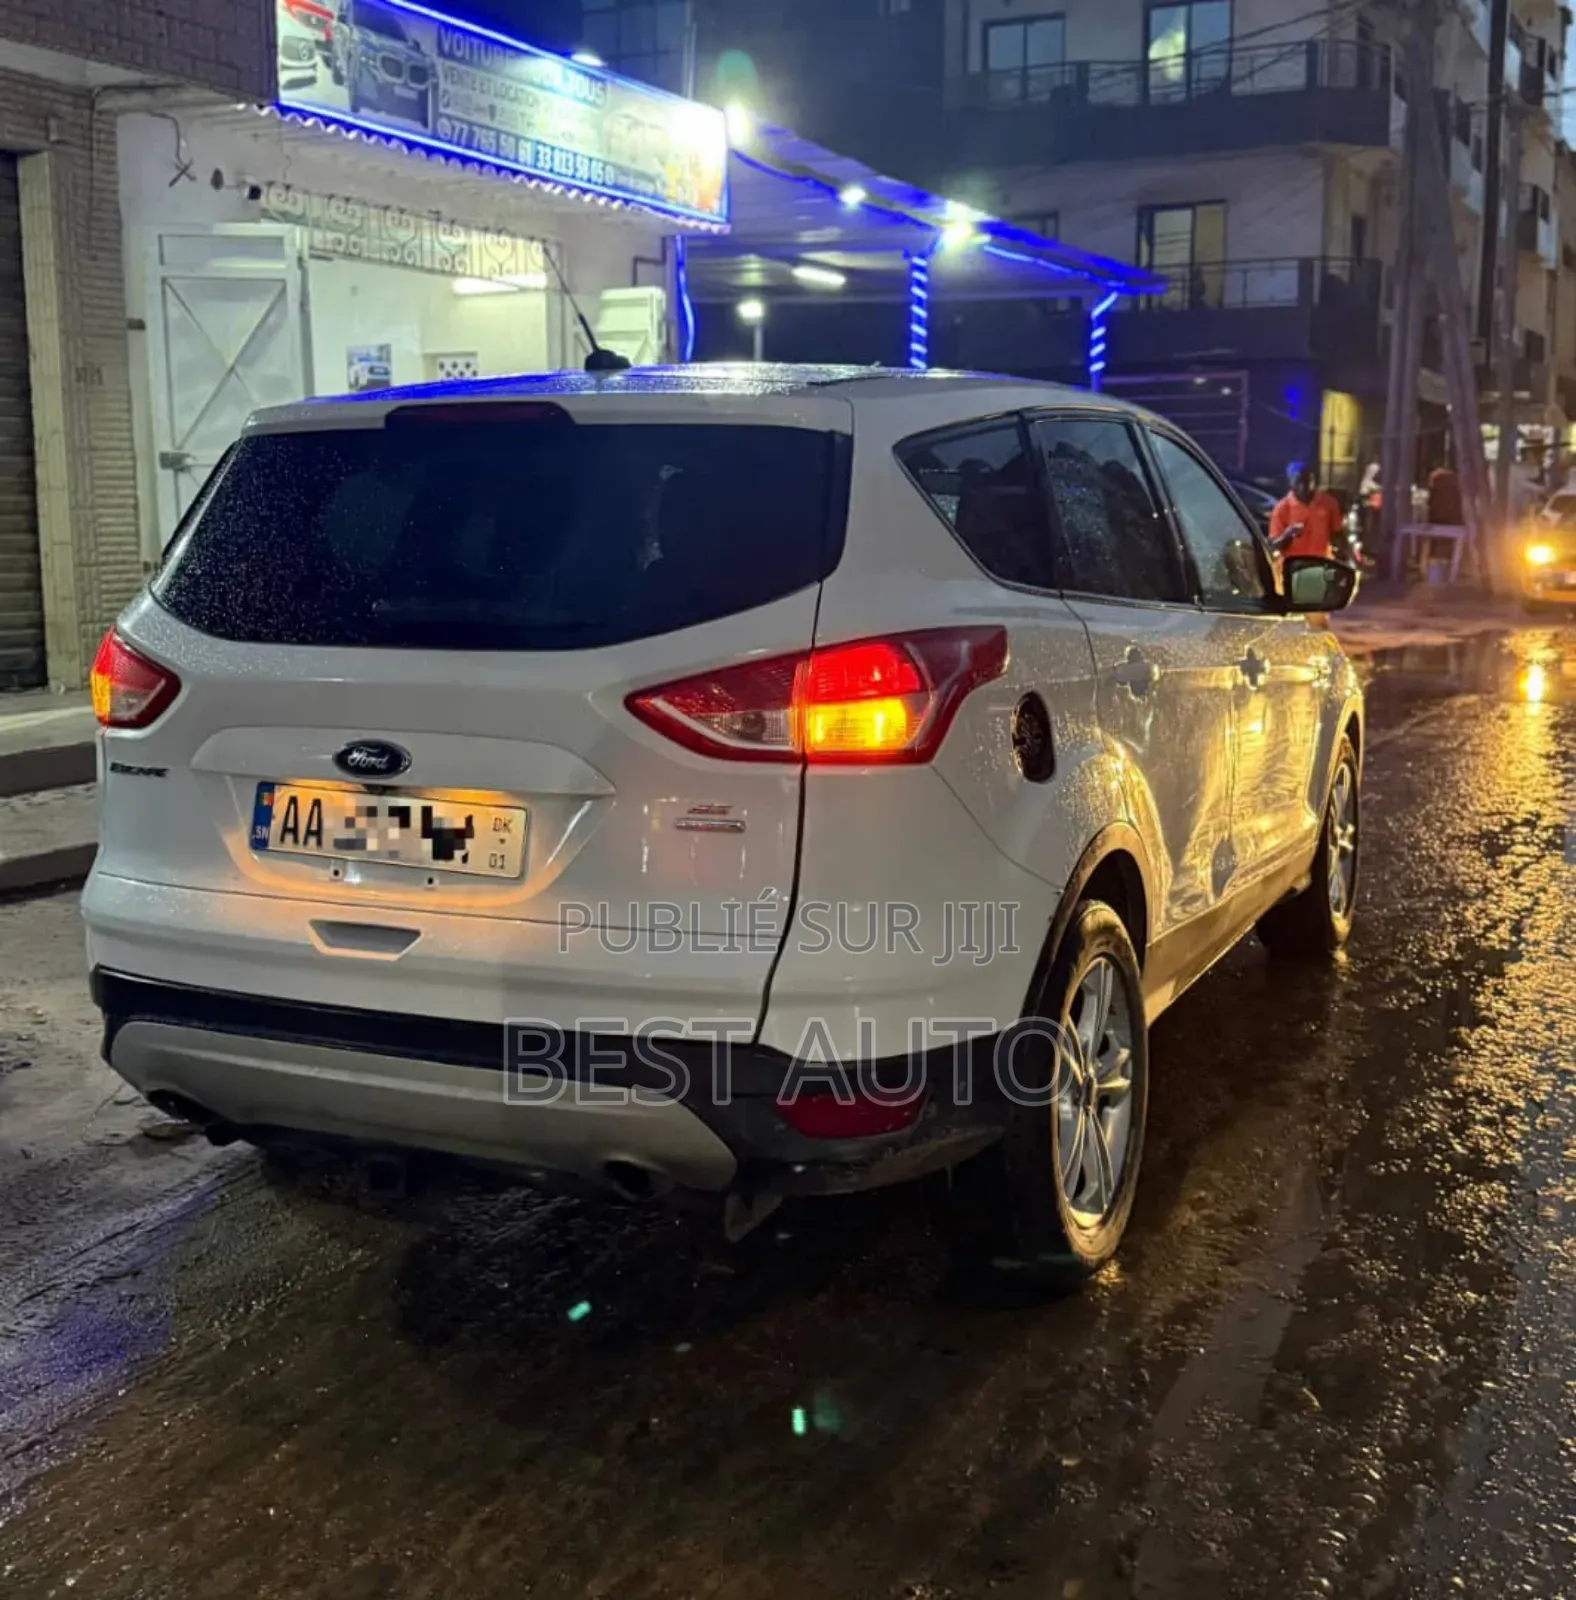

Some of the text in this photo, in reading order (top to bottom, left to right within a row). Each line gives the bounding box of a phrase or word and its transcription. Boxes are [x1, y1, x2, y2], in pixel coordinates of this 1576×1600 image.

[347, 748, 390, 770] Ford
[492, 817, 513, 833] DK
[488, 853, 506, 870] 01
